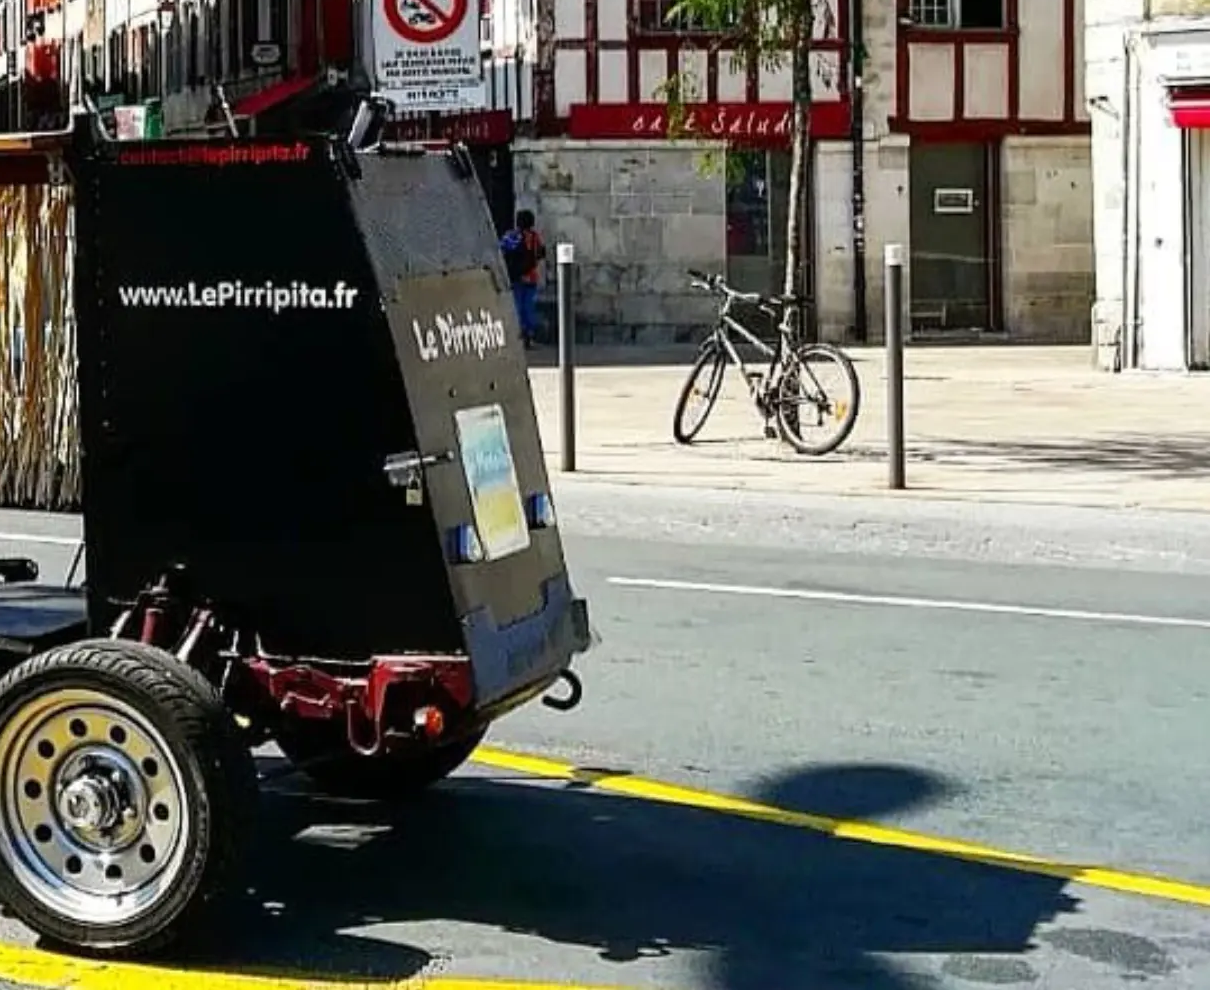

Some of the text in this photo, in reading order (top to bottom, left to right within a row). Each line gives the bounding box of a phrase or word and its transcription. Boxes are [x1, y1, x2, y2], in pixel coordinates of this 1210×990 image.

[119, 280, 358, 314] www.LePirripita.fr
[412, 308, 506, 361] Le Pirripita
